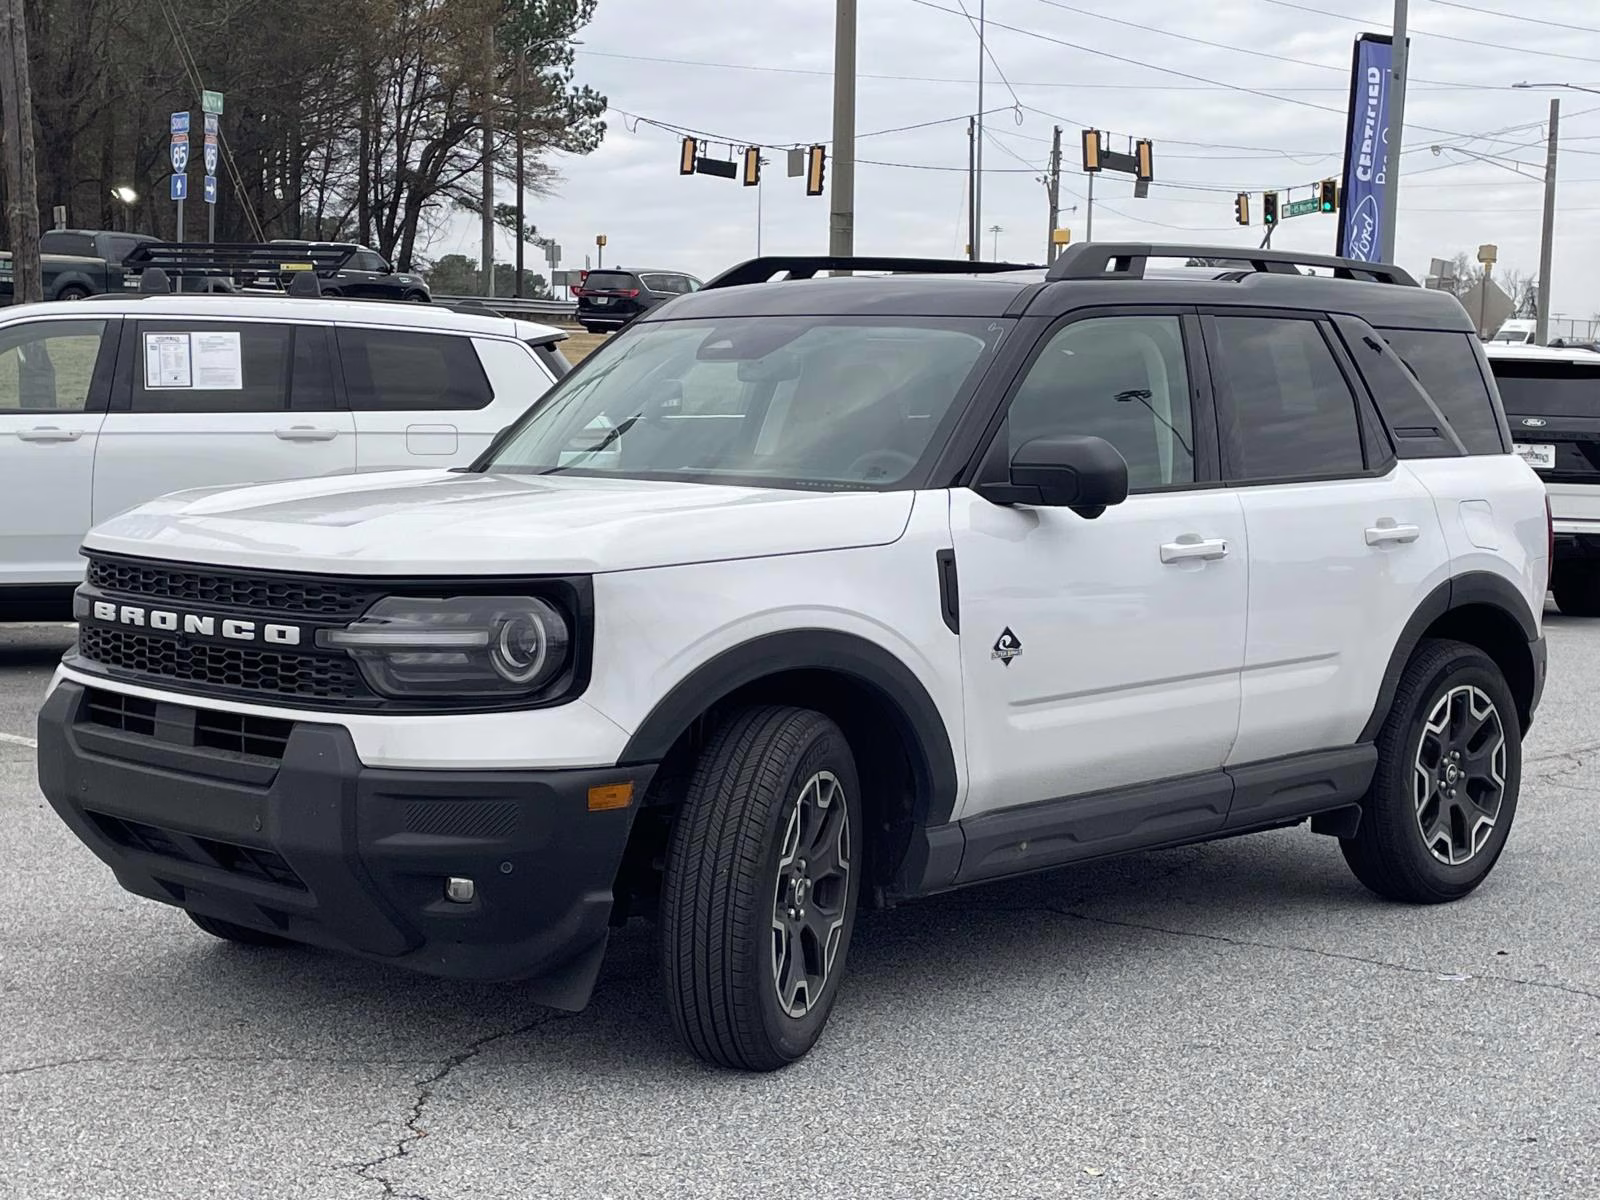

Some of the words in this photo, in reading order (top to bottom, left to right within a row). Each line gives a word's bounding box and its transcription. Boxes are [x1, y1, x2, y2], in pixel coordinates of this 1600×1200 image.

[173, 146, 187, 168] 85
[206, 148, 216, 171] 85
[1349, 212, 1374, 261] Ford
[93, 600, 301, 646] BRONCO
